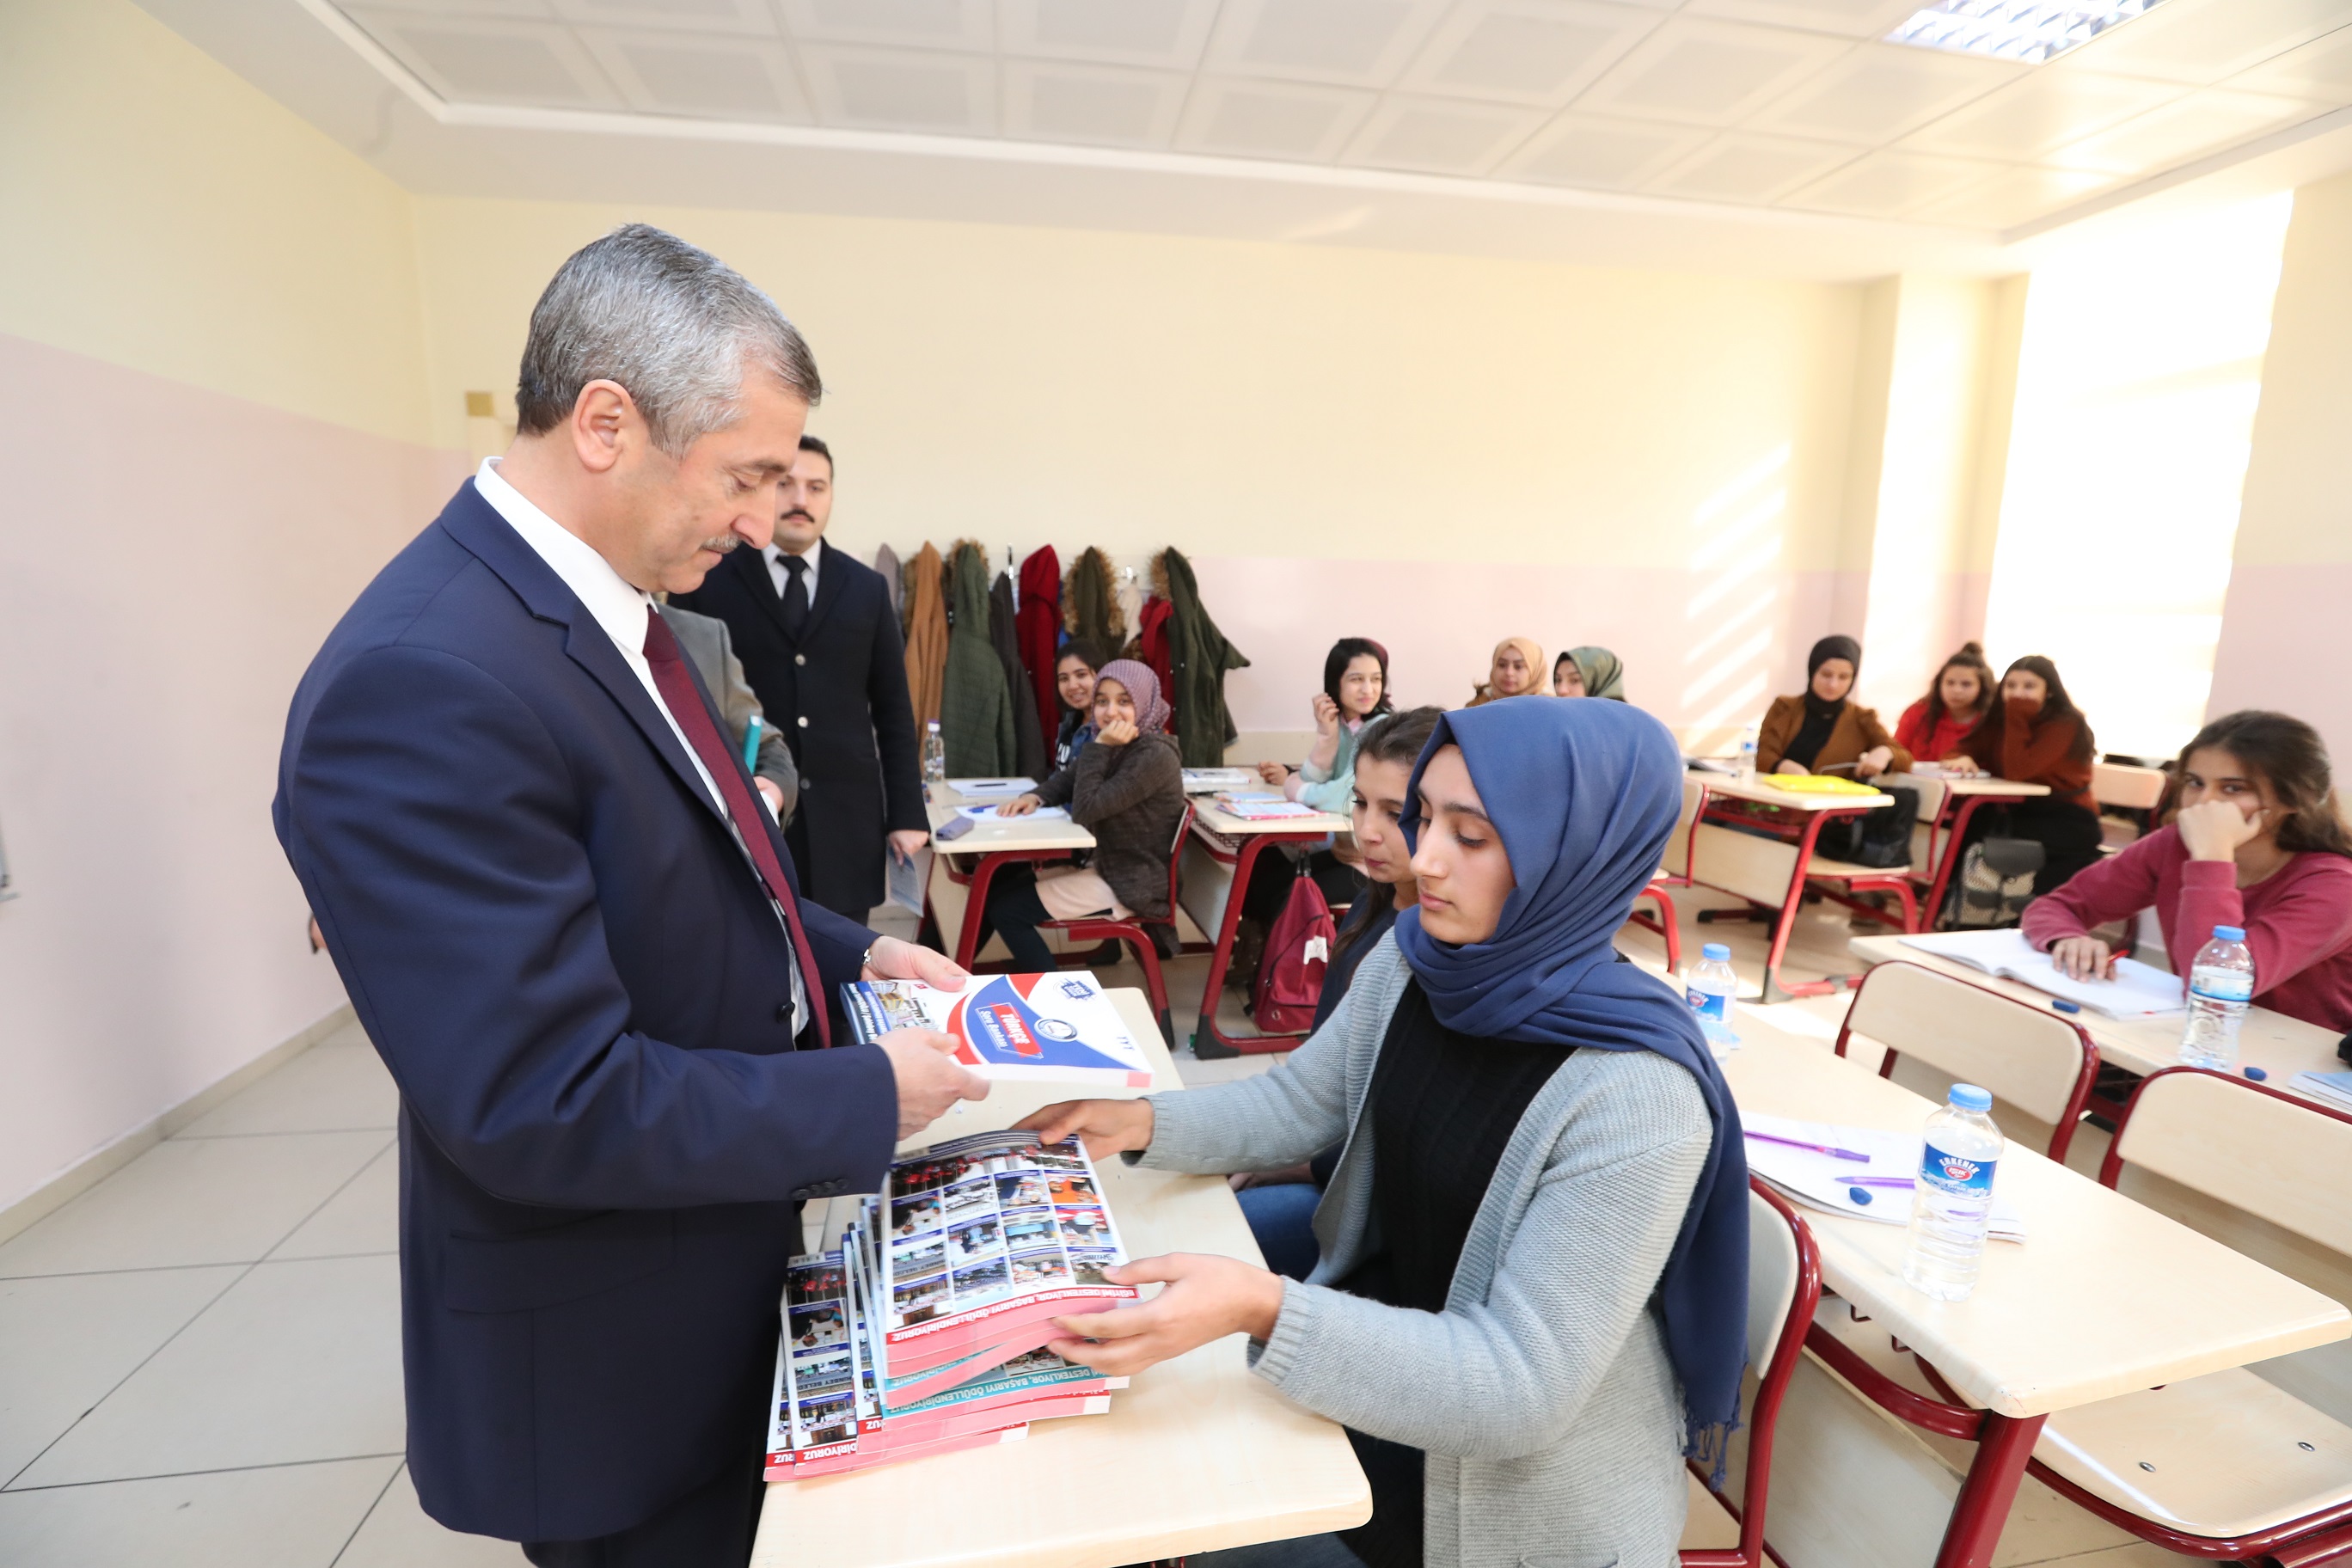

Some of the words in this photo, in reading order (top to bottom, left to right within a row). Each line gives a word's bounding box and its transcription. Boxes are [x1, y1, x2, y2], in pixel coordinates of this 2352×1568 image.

[980, 1010, 995, 1024] Soru
[987, 1024, 1008, 1048] Bankası
[1000, 1013, 1031, 1044] TÜRKÇE
[1939, 1157, 1980, 1174] ERKENEK
[1029, 1369, 1090, 1384] DESTEKLİYOR,
[986, 1377, 1029, 1393] BAŞARIYI
